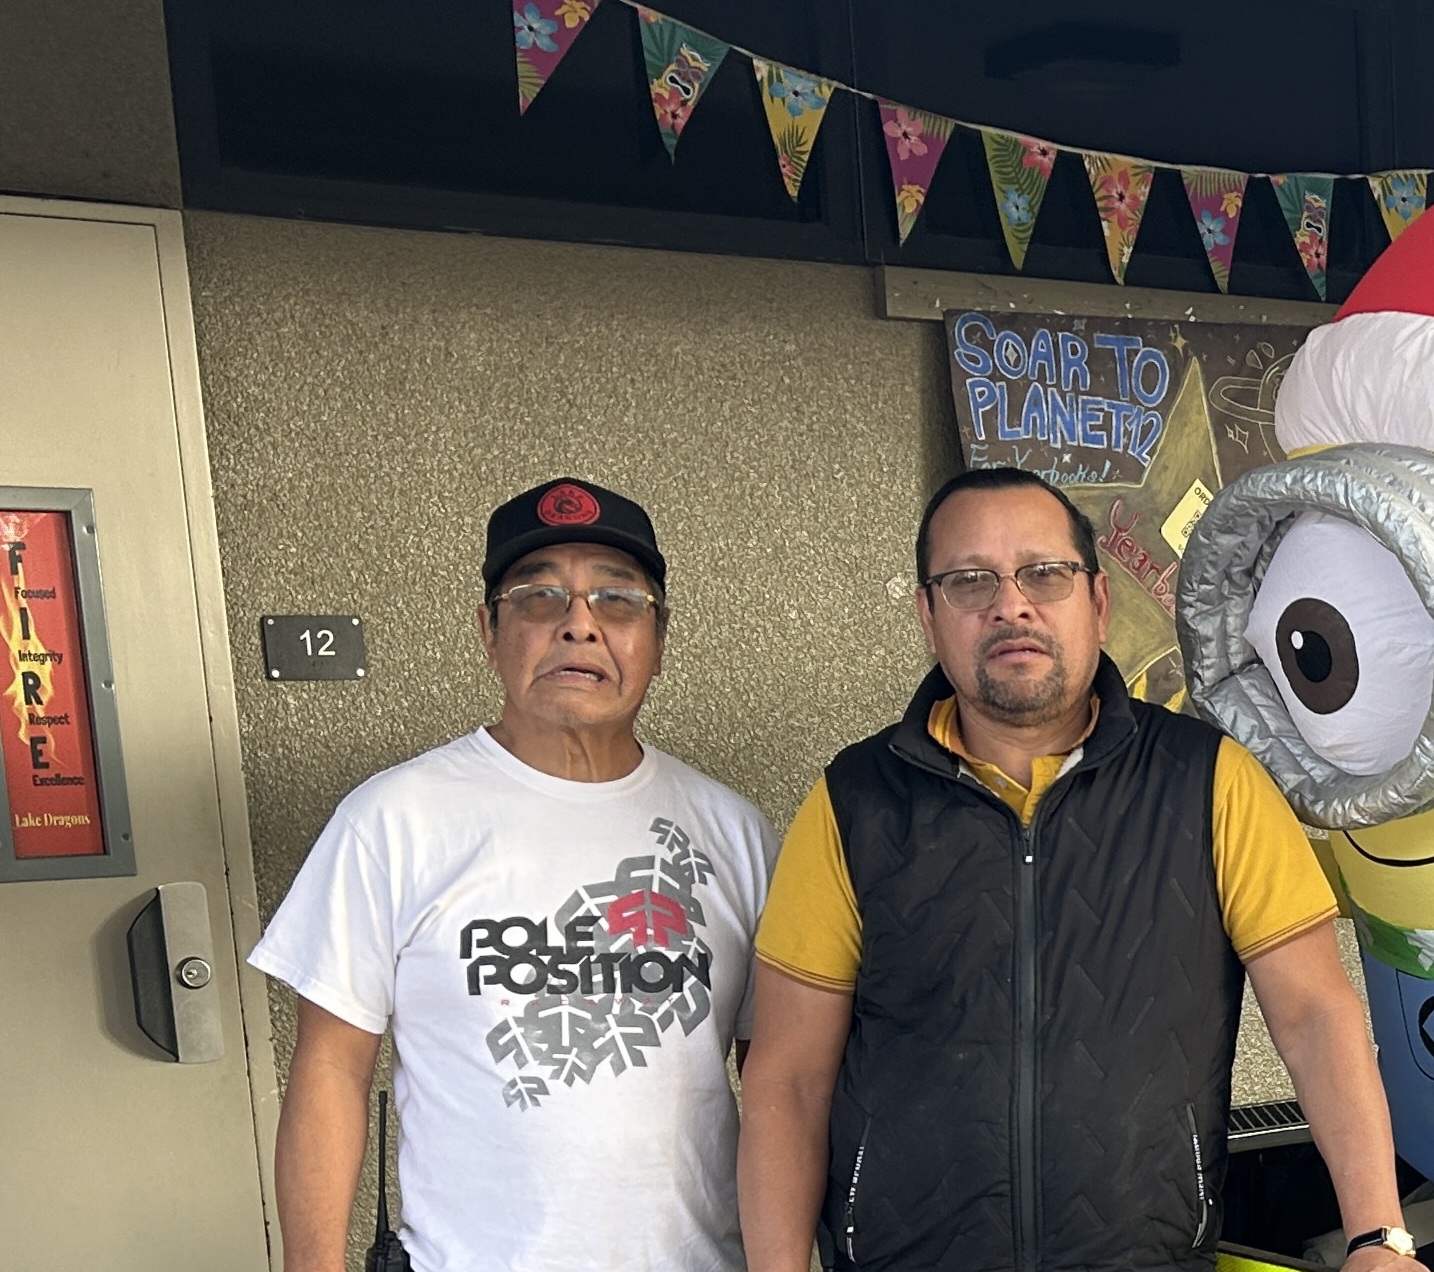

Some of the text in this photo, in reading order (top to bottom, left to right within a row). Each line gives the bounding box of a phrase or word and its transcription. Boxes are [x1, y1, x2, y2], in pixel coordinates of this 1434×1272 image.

[954, 312, 1170, 407] SOAR TO
[1012, 445, 1111, 486] Yrbooks!
[14, 586, 57, 600] Focused
[299, 629, 336, 656] 12
[18, 649, 63, 665] Integrity
[29, 712, 71, 729] Respect
[32, 773, 85, 787] Excellence
[15, 812, 91, 829] Lake Dragons
[459, 916, 602, 959] POLE
[466, 950, 712, 996] POSITION
